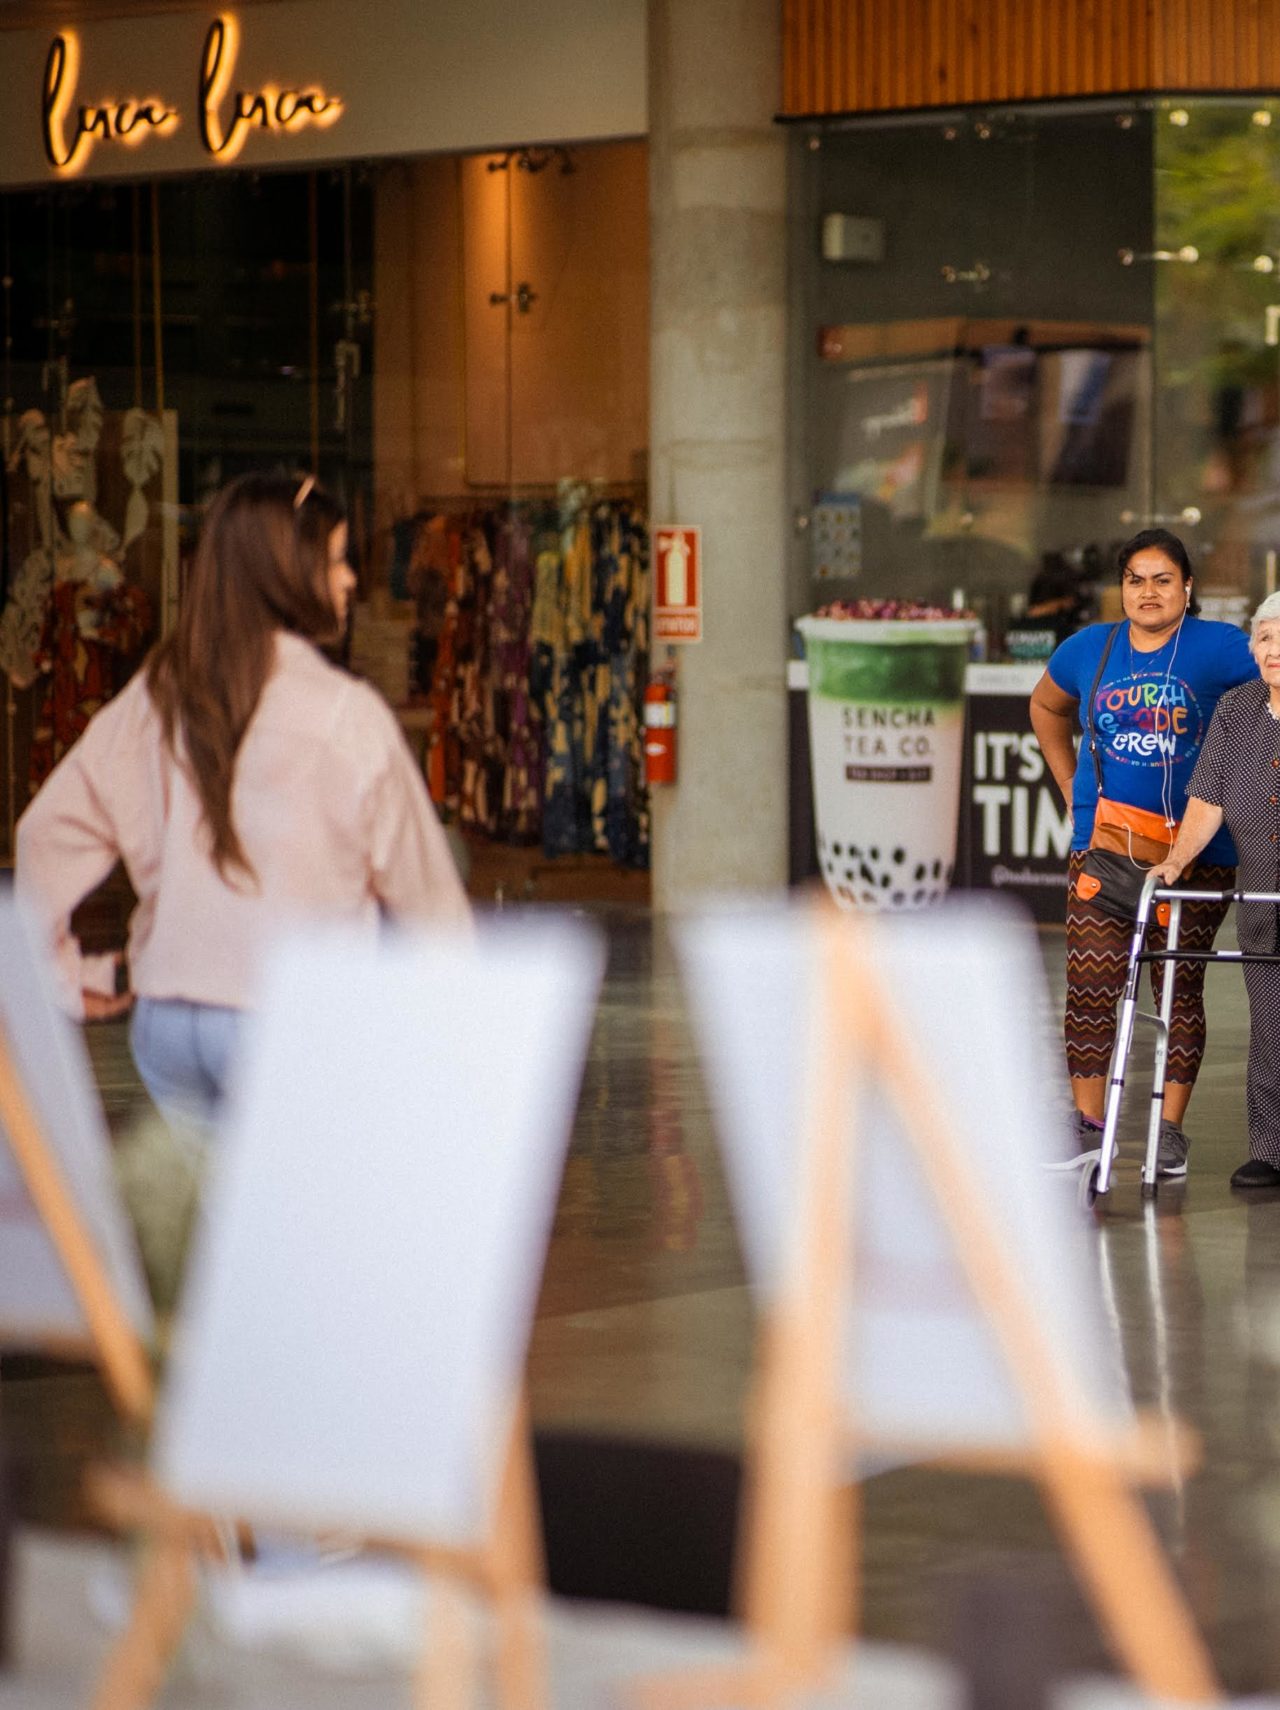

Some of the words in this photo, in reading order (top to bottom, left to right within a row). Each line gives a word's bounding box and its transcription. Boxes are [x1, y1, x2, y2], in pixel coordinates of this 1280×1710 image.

[1095, 683, 1187, 712] FOURTH
[843, 707, 936, 727] SENCHA
[843, 736, 887, 755] TEA
[974, 732, 1044, 782] IT'S
